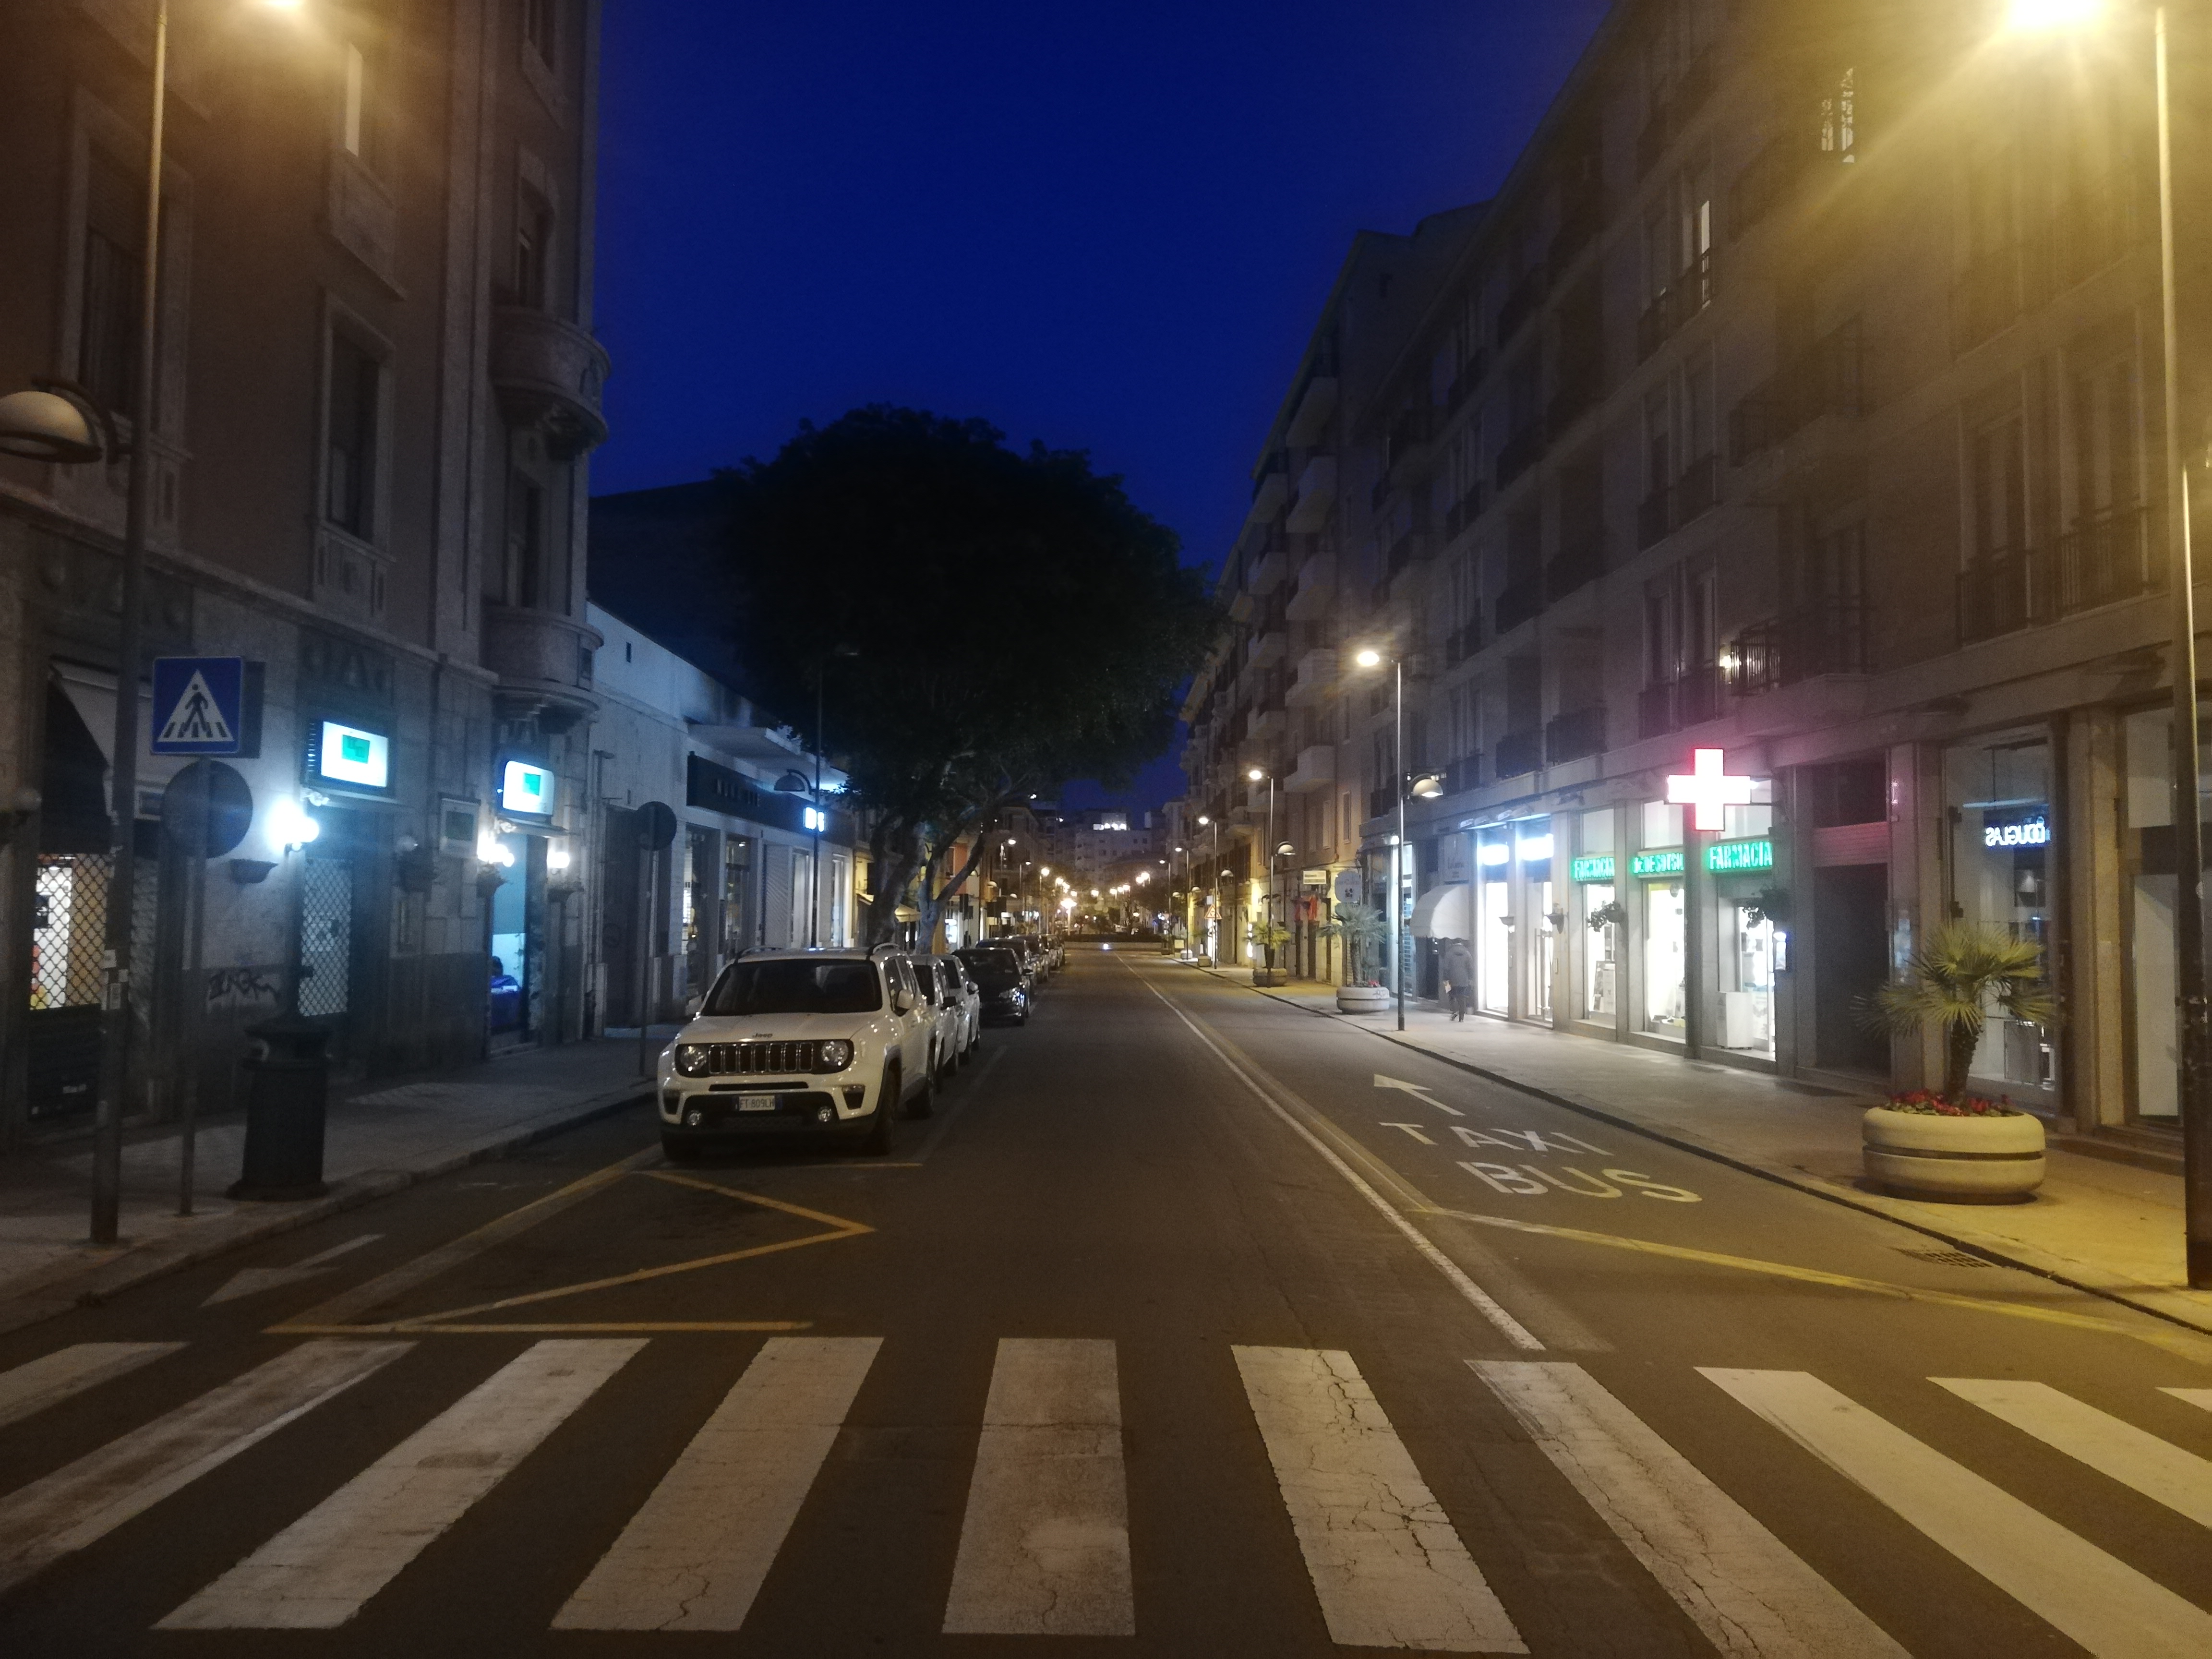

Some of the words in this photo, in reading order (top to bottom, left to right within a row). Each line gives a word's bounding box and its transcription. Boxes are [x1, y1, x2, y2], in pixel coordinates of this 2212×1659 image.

[1709, 841, 1773, 870] FARMACIA
[1379, 1121, 1615, 1157] TAXI
[1456, 1161, 1703, 1203] BUS
